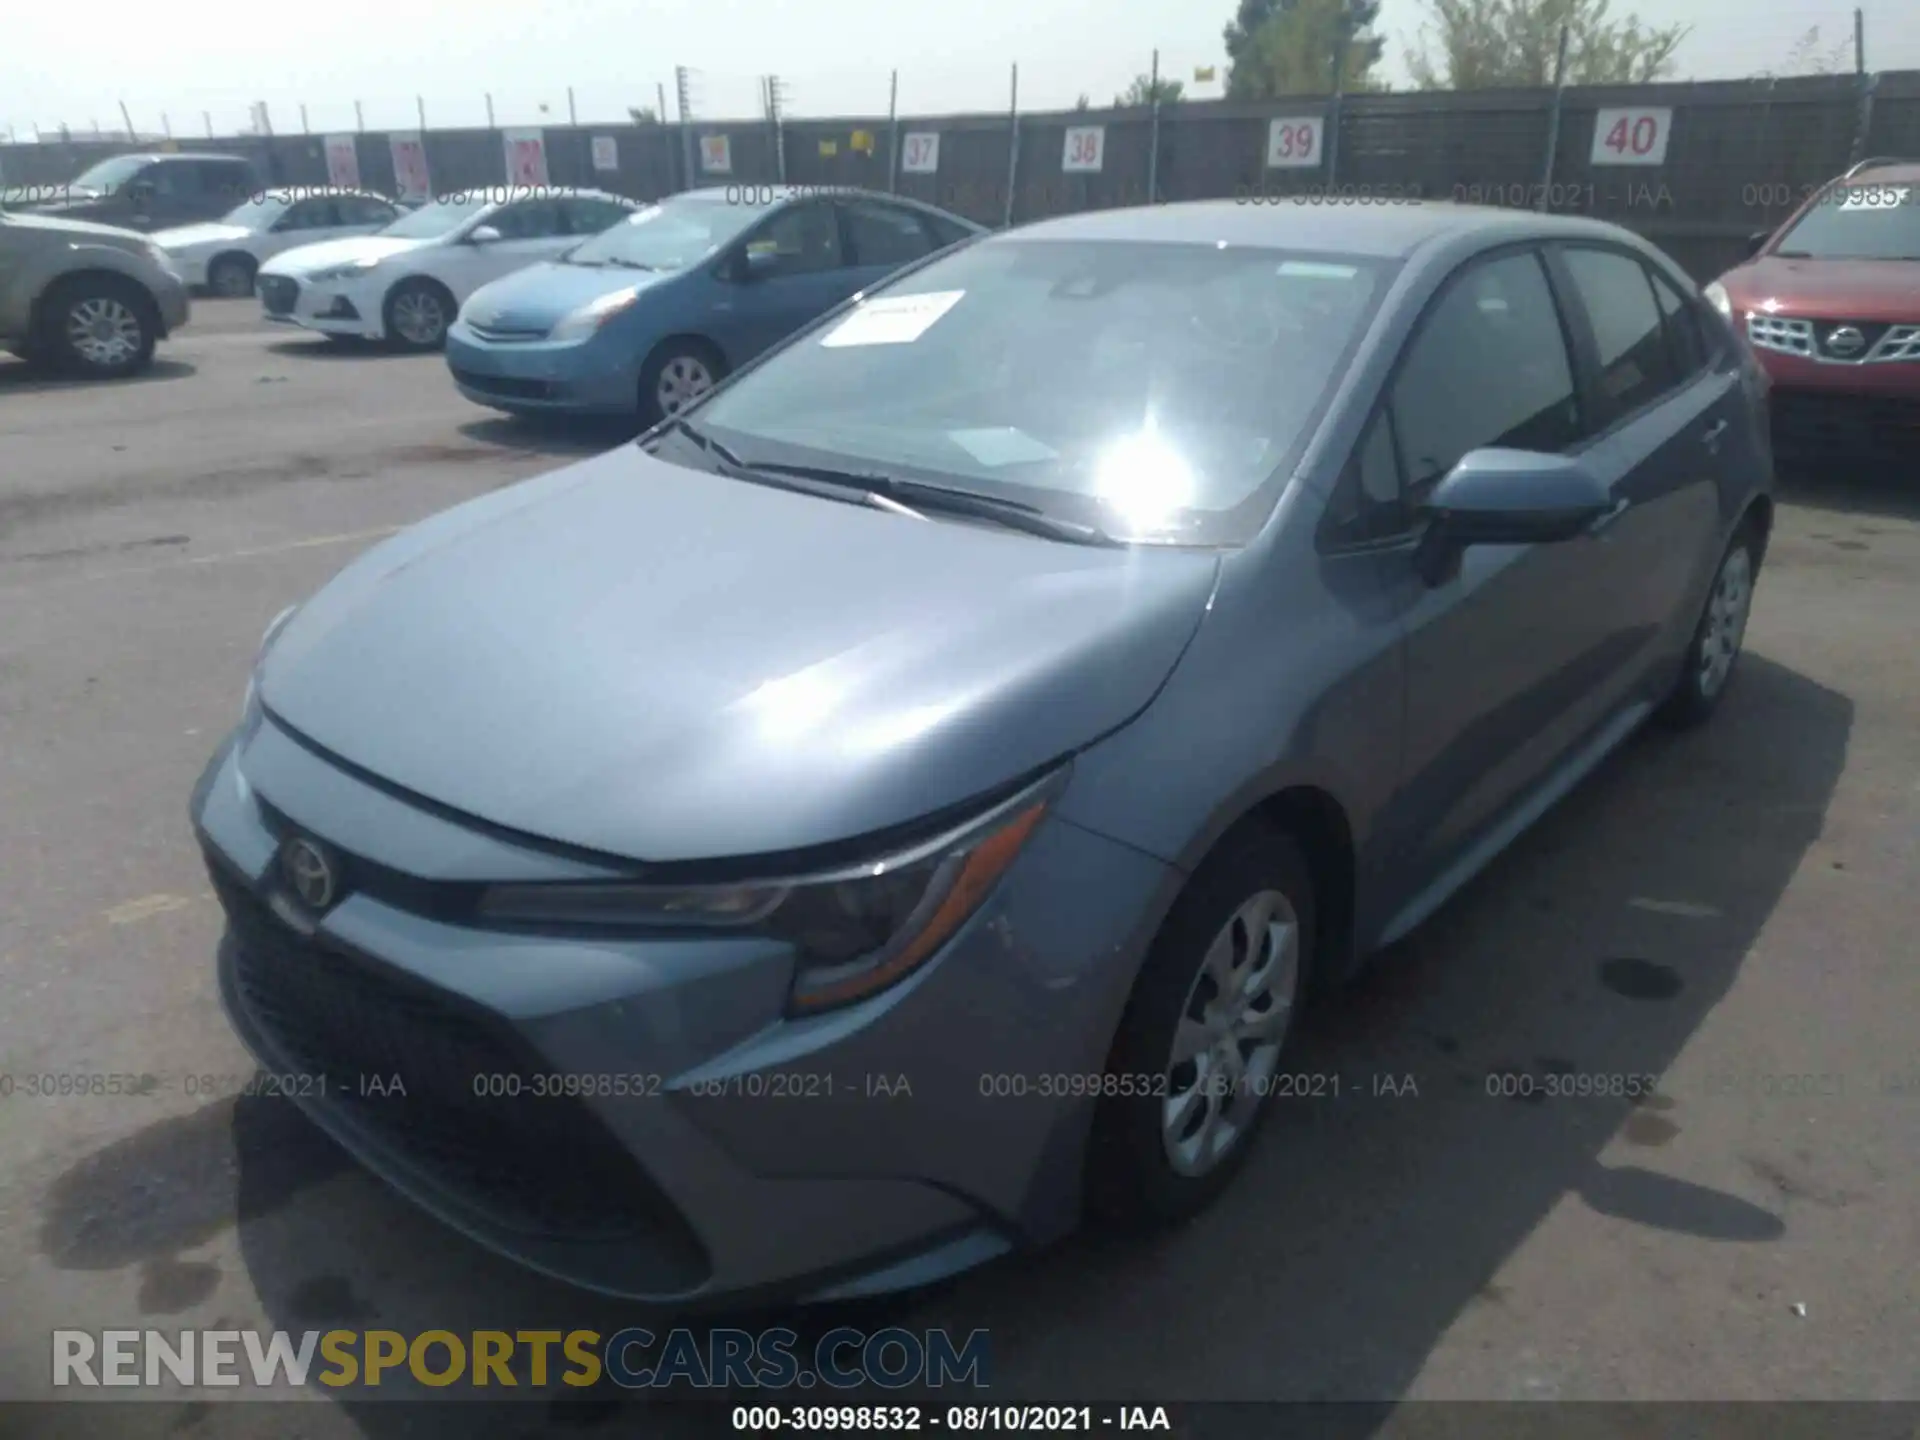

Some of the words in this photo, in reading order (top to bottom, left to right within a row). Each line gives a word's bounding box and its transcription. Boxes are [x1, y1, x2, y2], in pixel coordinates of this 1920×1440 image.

[908, 137, 933, 167] 37
[1071, 132, 1098, 165] 38
[1276, 124, 1314, 160] 39
[1605, 115, 1658, 155] 40
